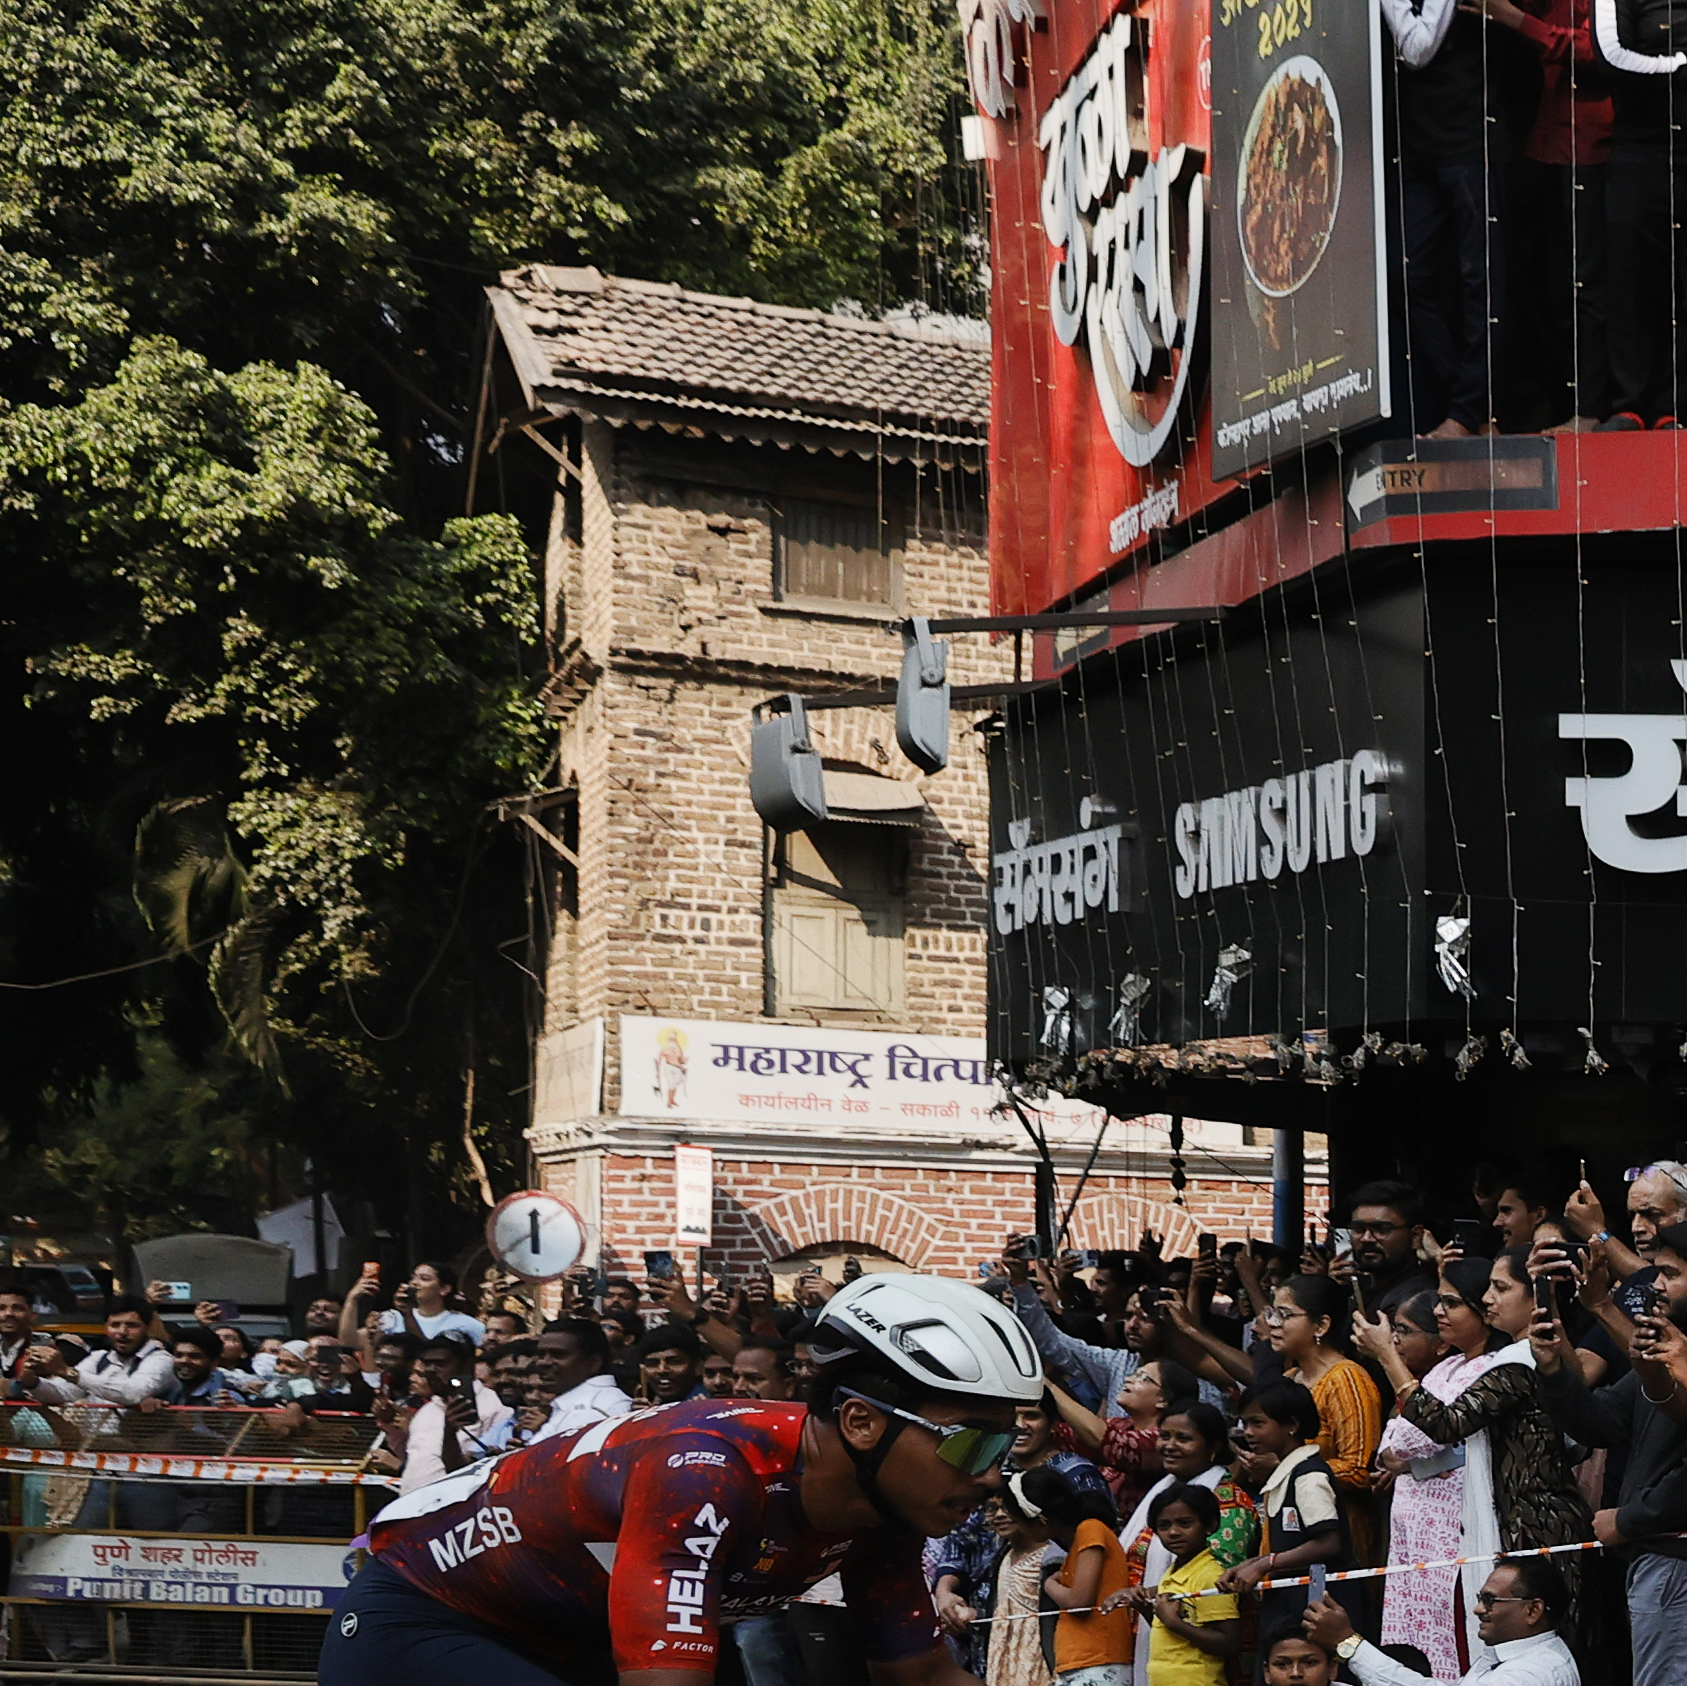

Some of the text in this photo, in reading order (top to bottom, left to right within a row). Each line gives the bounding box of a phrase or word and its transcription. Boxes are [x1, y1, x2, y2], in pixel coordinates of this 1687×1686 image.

[1175, 749, 1377, 899] SAMSUNG
[711, 1043, 873, 1089] महाराष्ट्र
[738, 1092, 832, 1112] कार्यालयीन
[841, 1093, 870, 1114] वेळ
[900, 1100, 960, 1120] सकाळी
[845, 1302, 886, 1334] LAZER
[685, 1451, 727, 1461] PRO
[92, 1539, 259, 1567] पुणे शहर पोलीस
[427, 1506, 523, 1573] MZSB
[66, 1577, 145, 1600] Punit
[149, 1580, 230, 1604] Balan
[236, 1584, 324, 1609] Group
[672, 1641, 713, 1653] FACTOR
